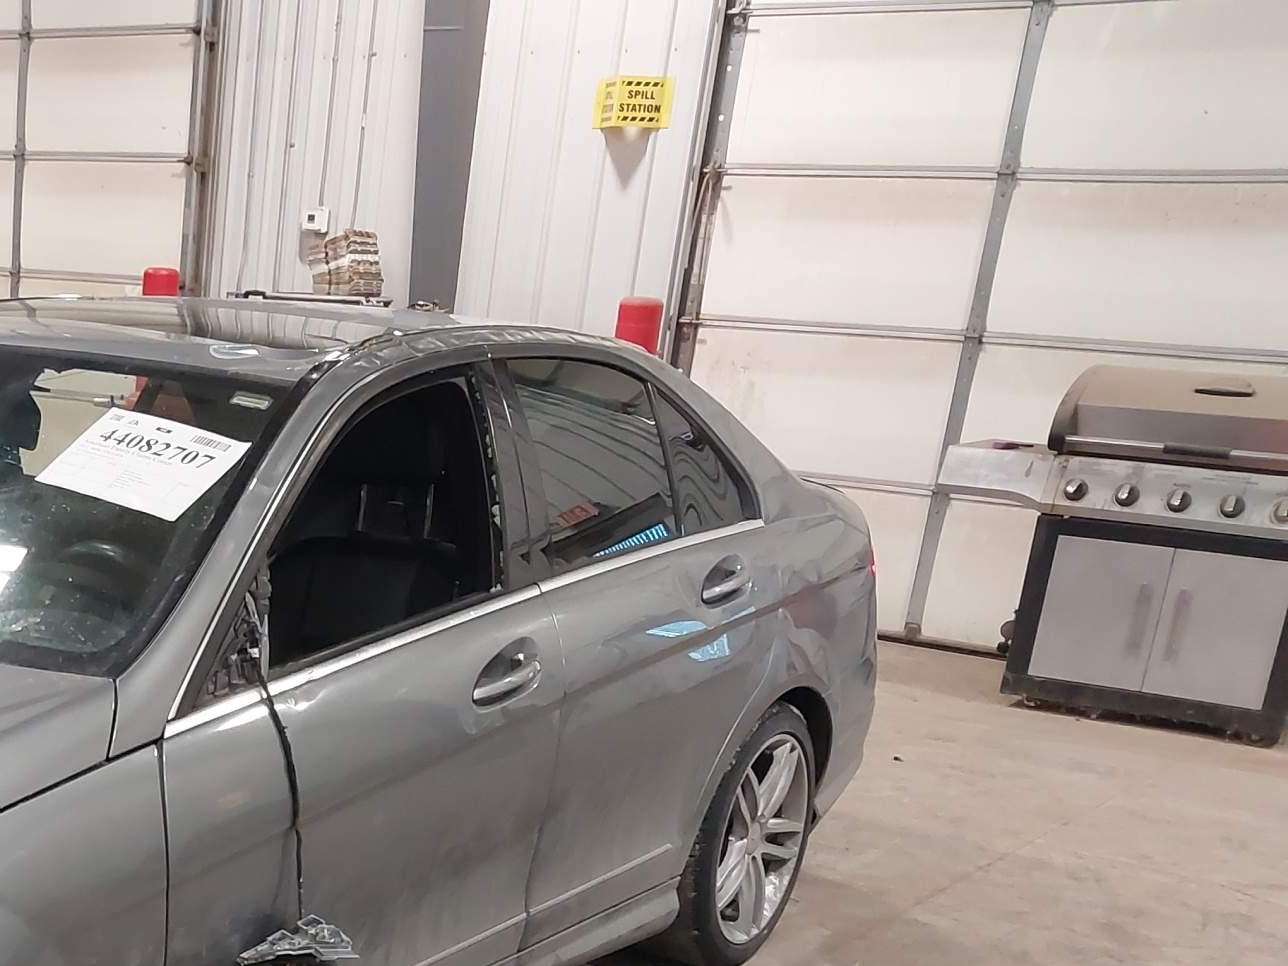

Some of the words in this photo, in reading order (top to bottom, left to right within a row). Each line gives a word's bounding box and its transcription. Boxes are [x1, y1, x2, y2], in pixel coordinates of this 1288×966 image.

[627, 90, 656, 100] SPILL
[618, 103, 661, 114] STATION
[99, 429, 217, 469] 44082707
